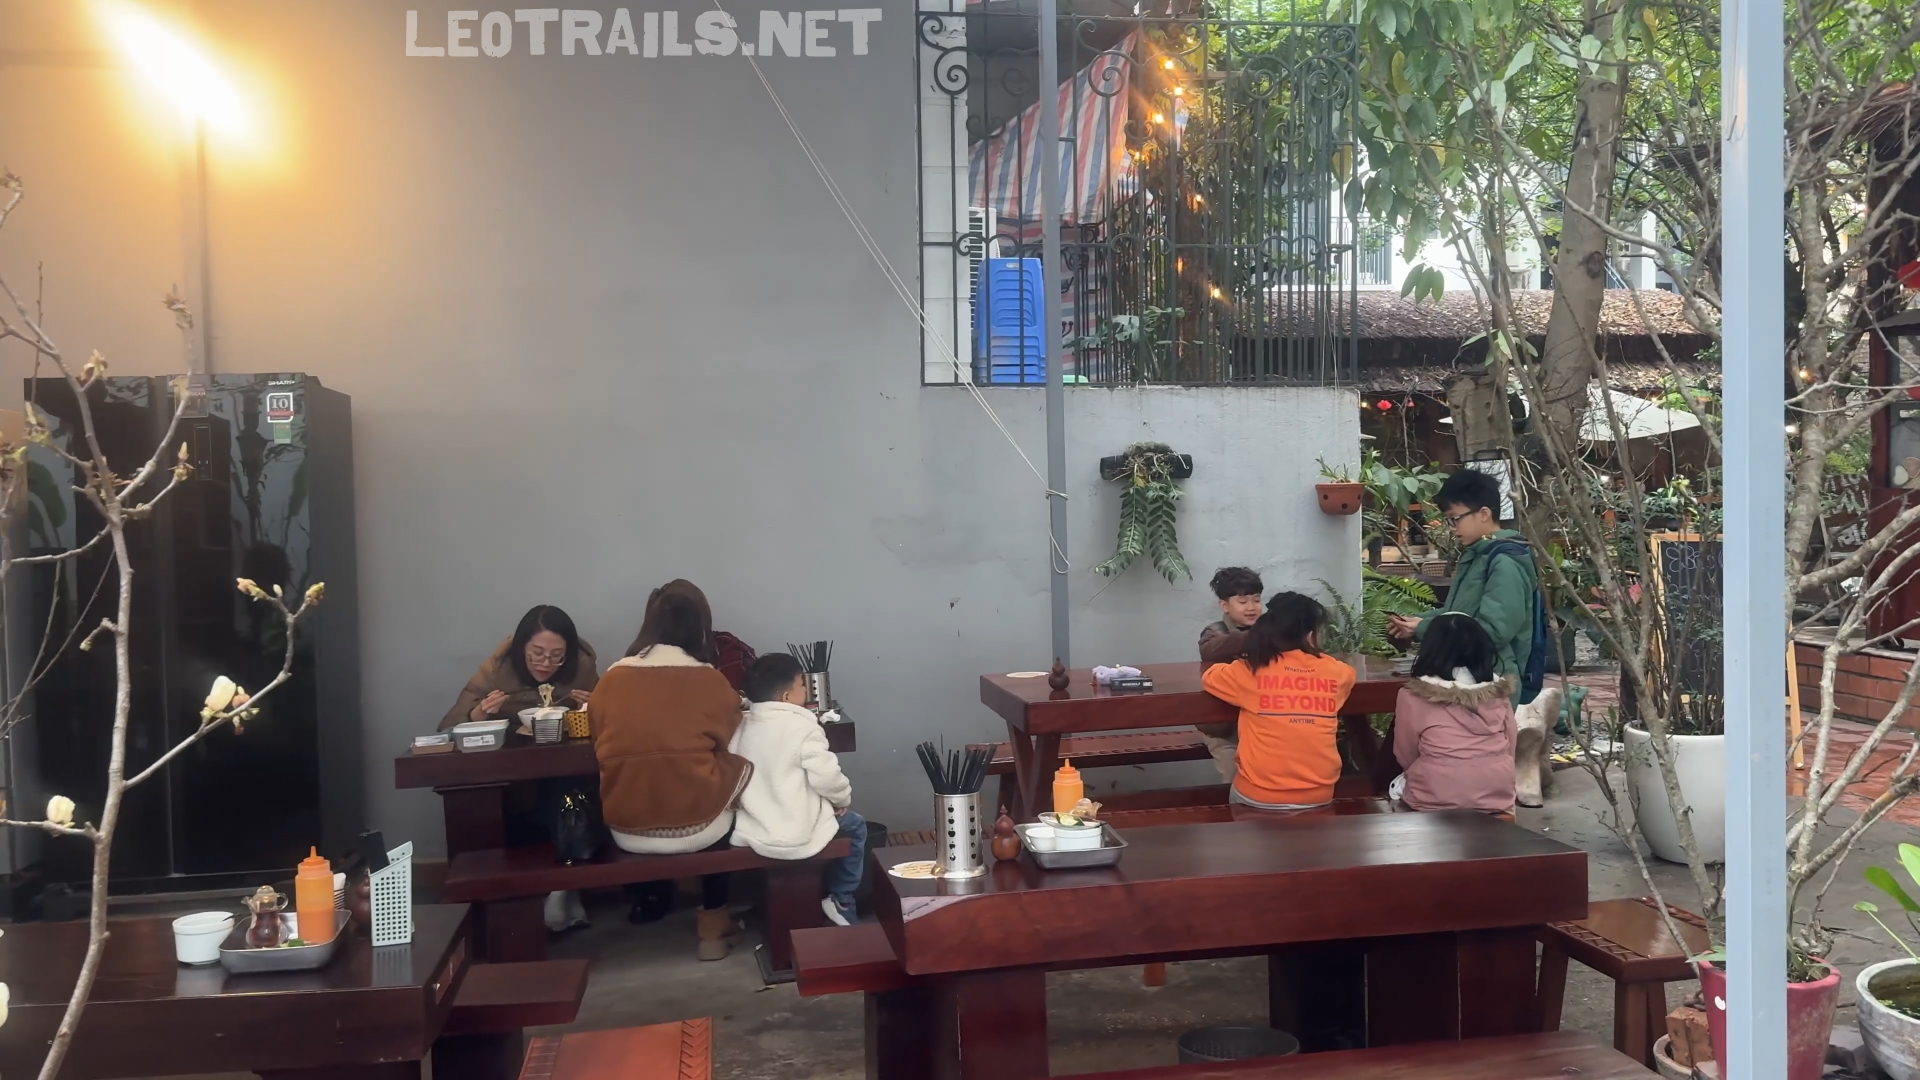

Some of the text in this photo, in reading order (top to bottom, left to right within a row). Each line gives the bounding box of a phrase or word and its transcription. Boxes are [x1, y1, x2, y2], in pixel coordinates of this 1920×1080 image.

[271, 398, 289, 409] 10
[1256, 675, 1338, 694] IMAGINE
[1259, 694, 1337, 713] BEYOND
